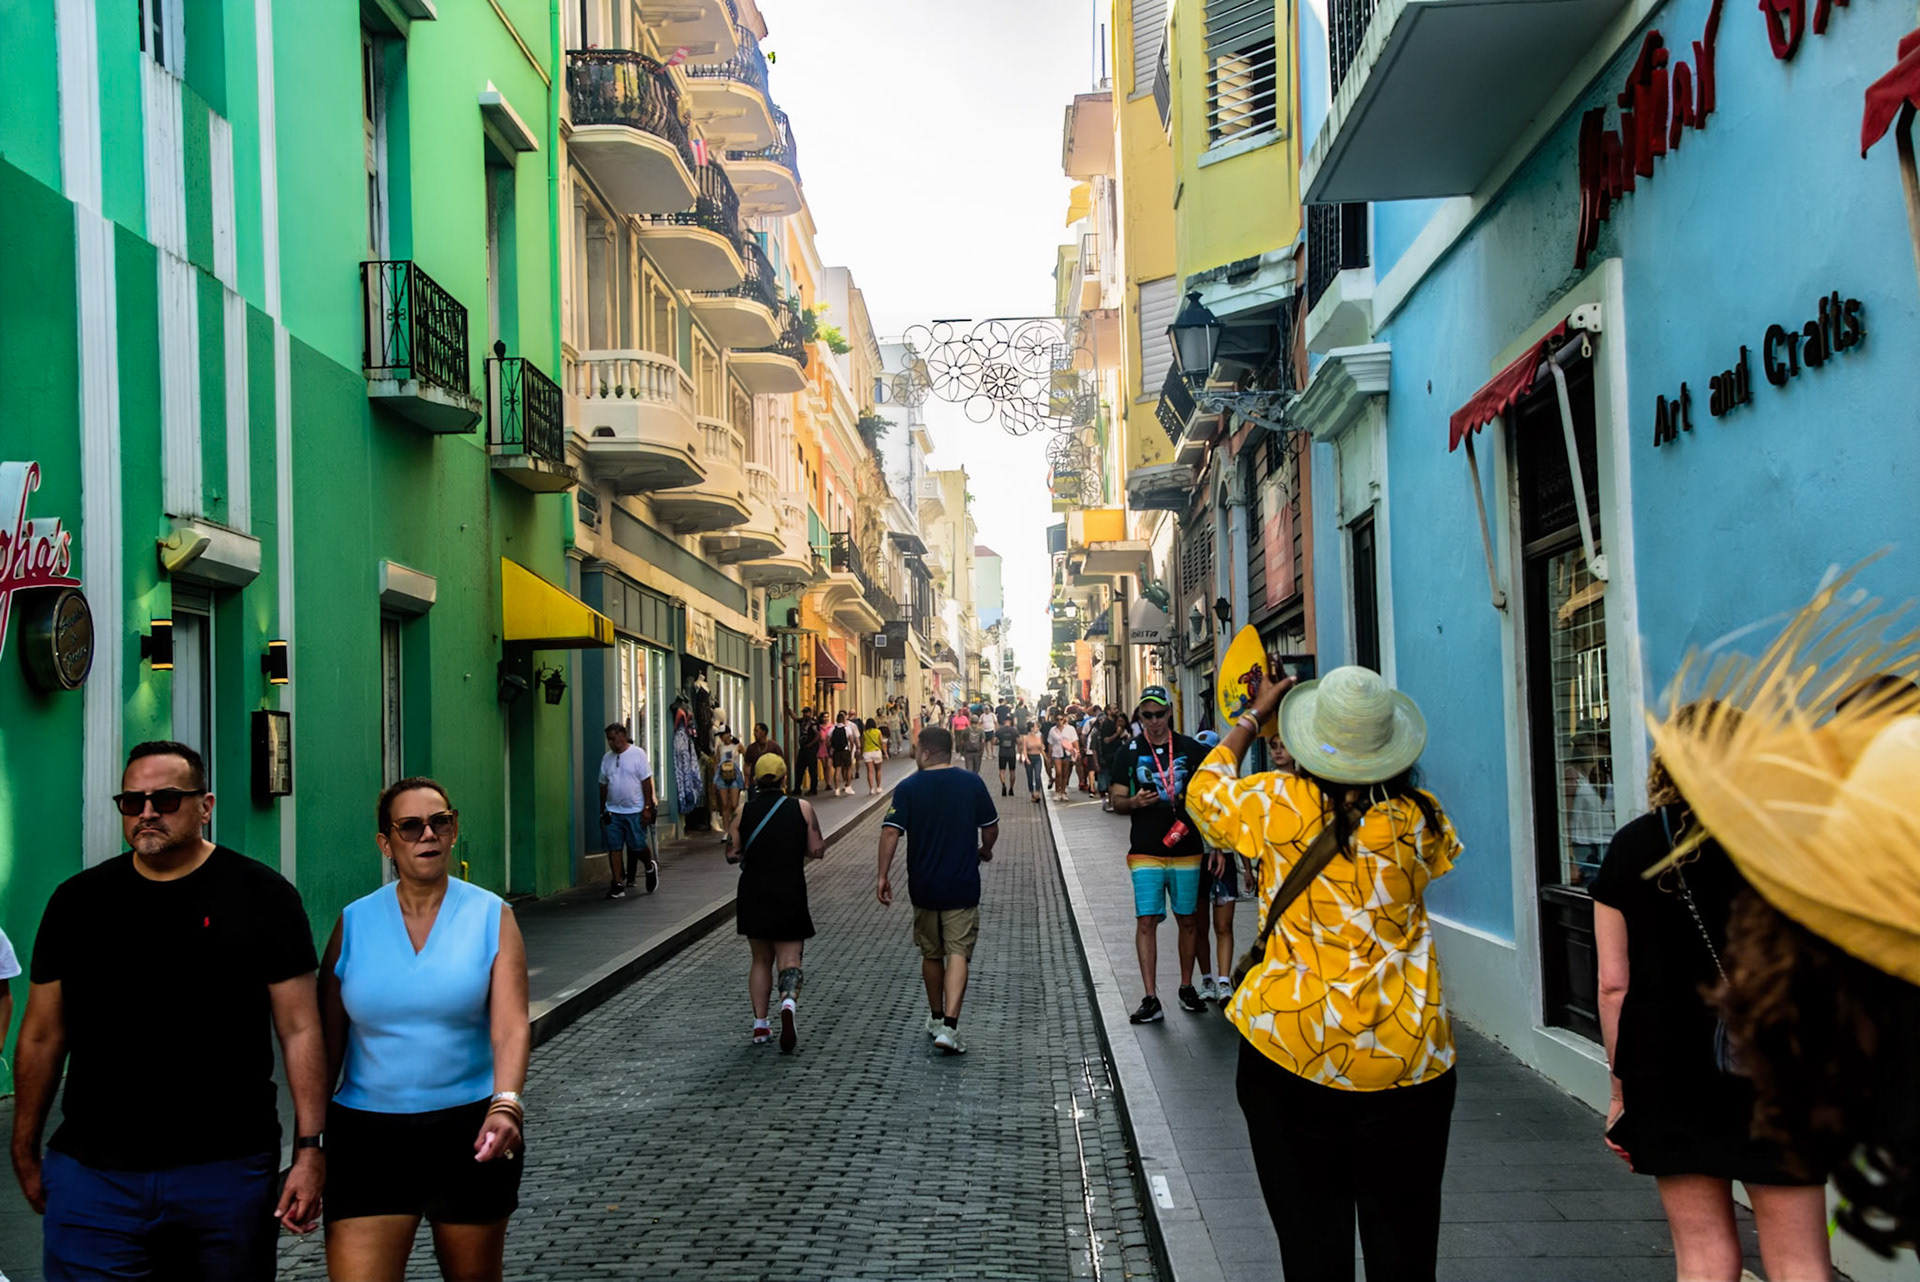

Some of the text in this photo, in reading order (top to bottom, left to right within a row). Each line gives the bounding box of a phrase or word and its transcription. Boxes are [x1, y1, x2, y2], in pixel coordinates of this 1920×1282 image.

[1654, 290, 1862, 447] Art and Crafts
